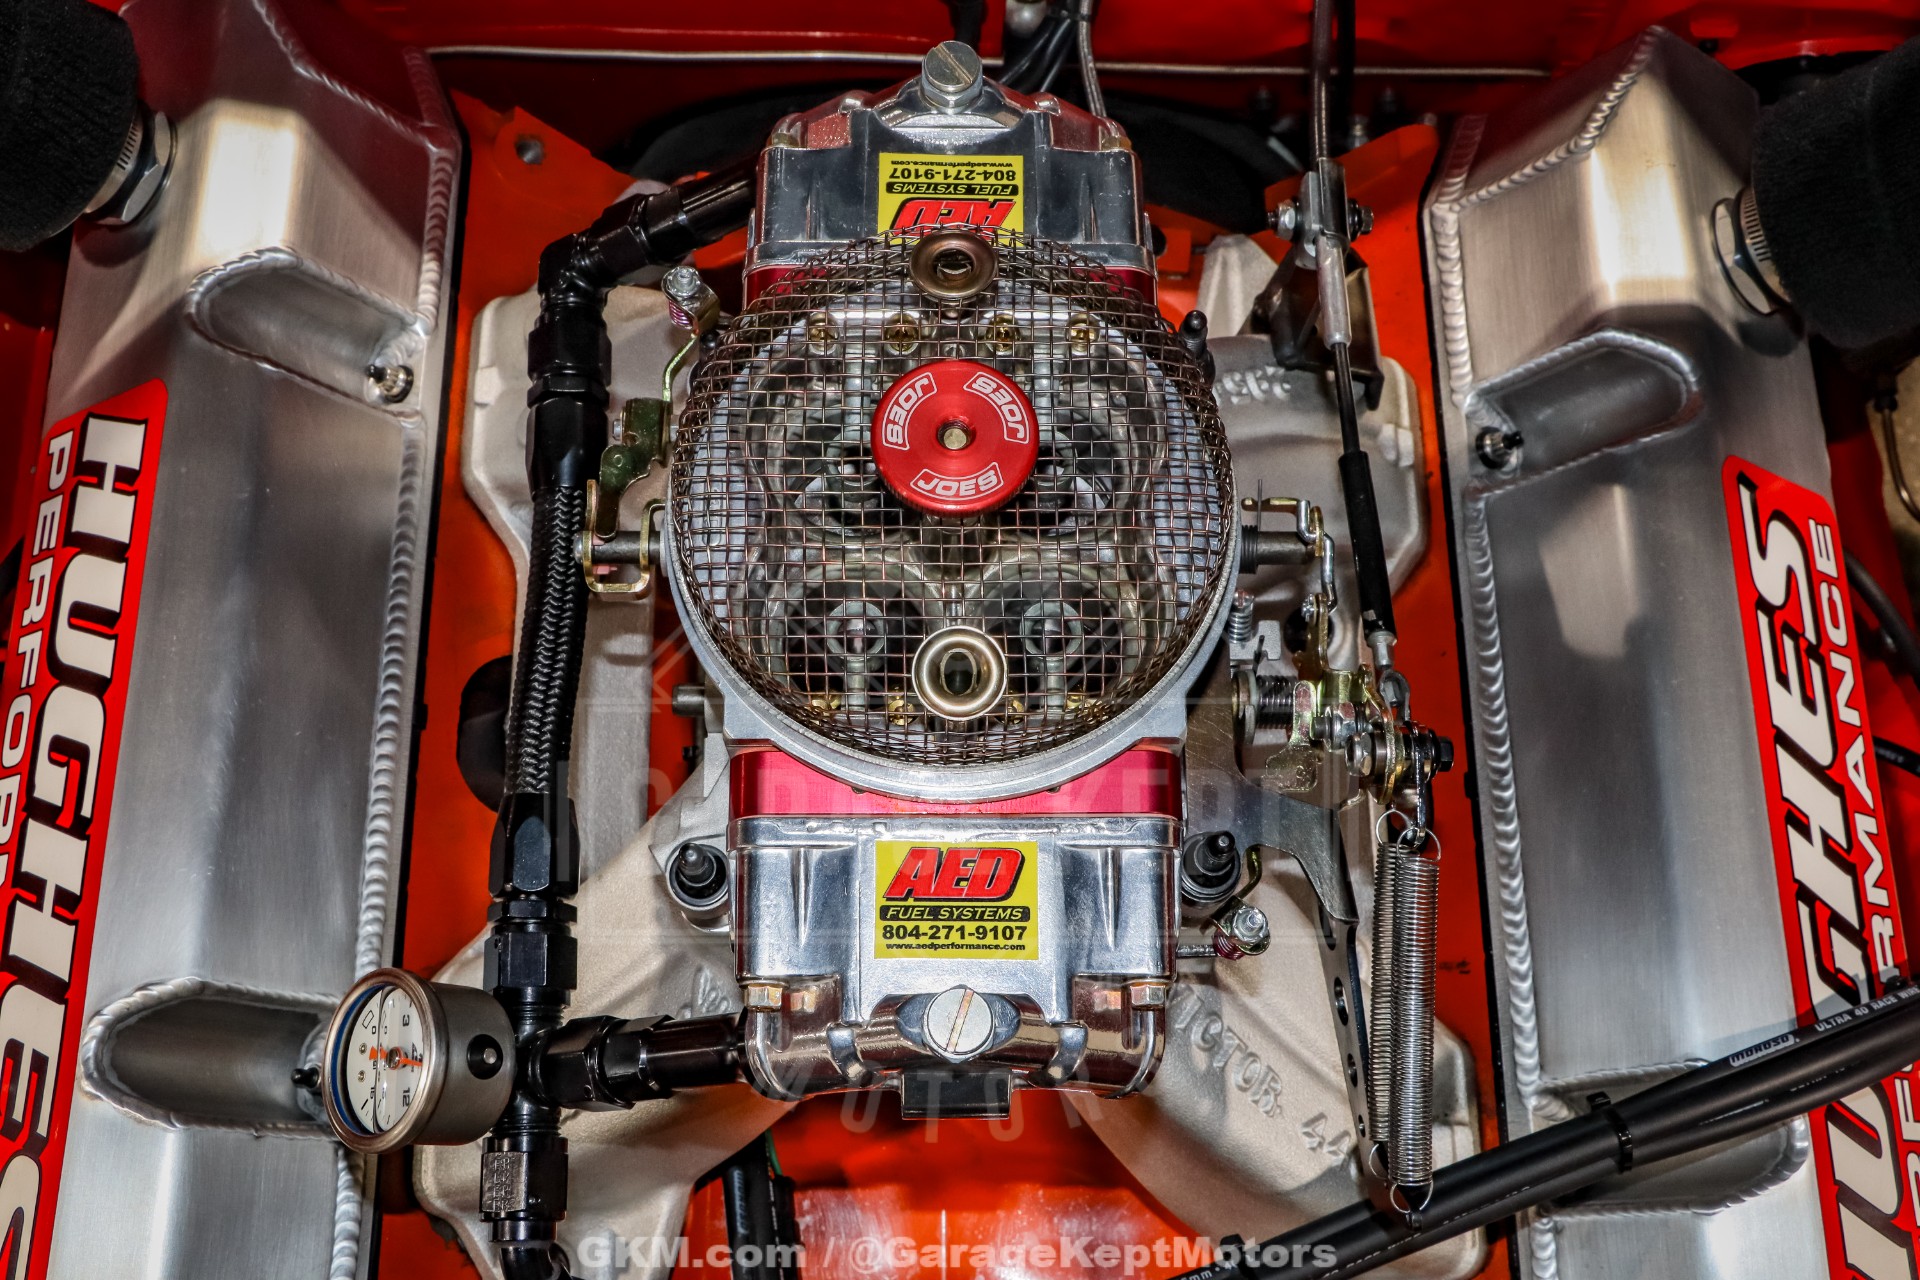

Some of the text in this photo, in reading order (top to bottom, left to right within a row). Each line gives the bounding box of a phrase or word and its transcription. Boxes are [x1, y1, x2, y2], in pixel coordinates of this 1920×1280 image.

[889, 168, 1016, 182] 804-271-9107
[892, 183, 1013, 195] FUEL SYSTEMS
[886, 377, 930, 446] JOES
[971, 376, 1025, 440] JOES
[917, 469, 998, 497] JOES
[884, 846, 1028, 901] AED
[886, 906, 1024, 919] FUEL SYSTEMS
[881, 924, 1028, 942] 804-271-9107
[885, 942, 1026, 952] www.aedperformance.com
[1814, 1013, 1853, 1032] ULTRA
[1854, 1005, 1869, 1019] 40
[1870, 994, 1897, 1012] RACE
[402, 1087, 411, 1107] 12
